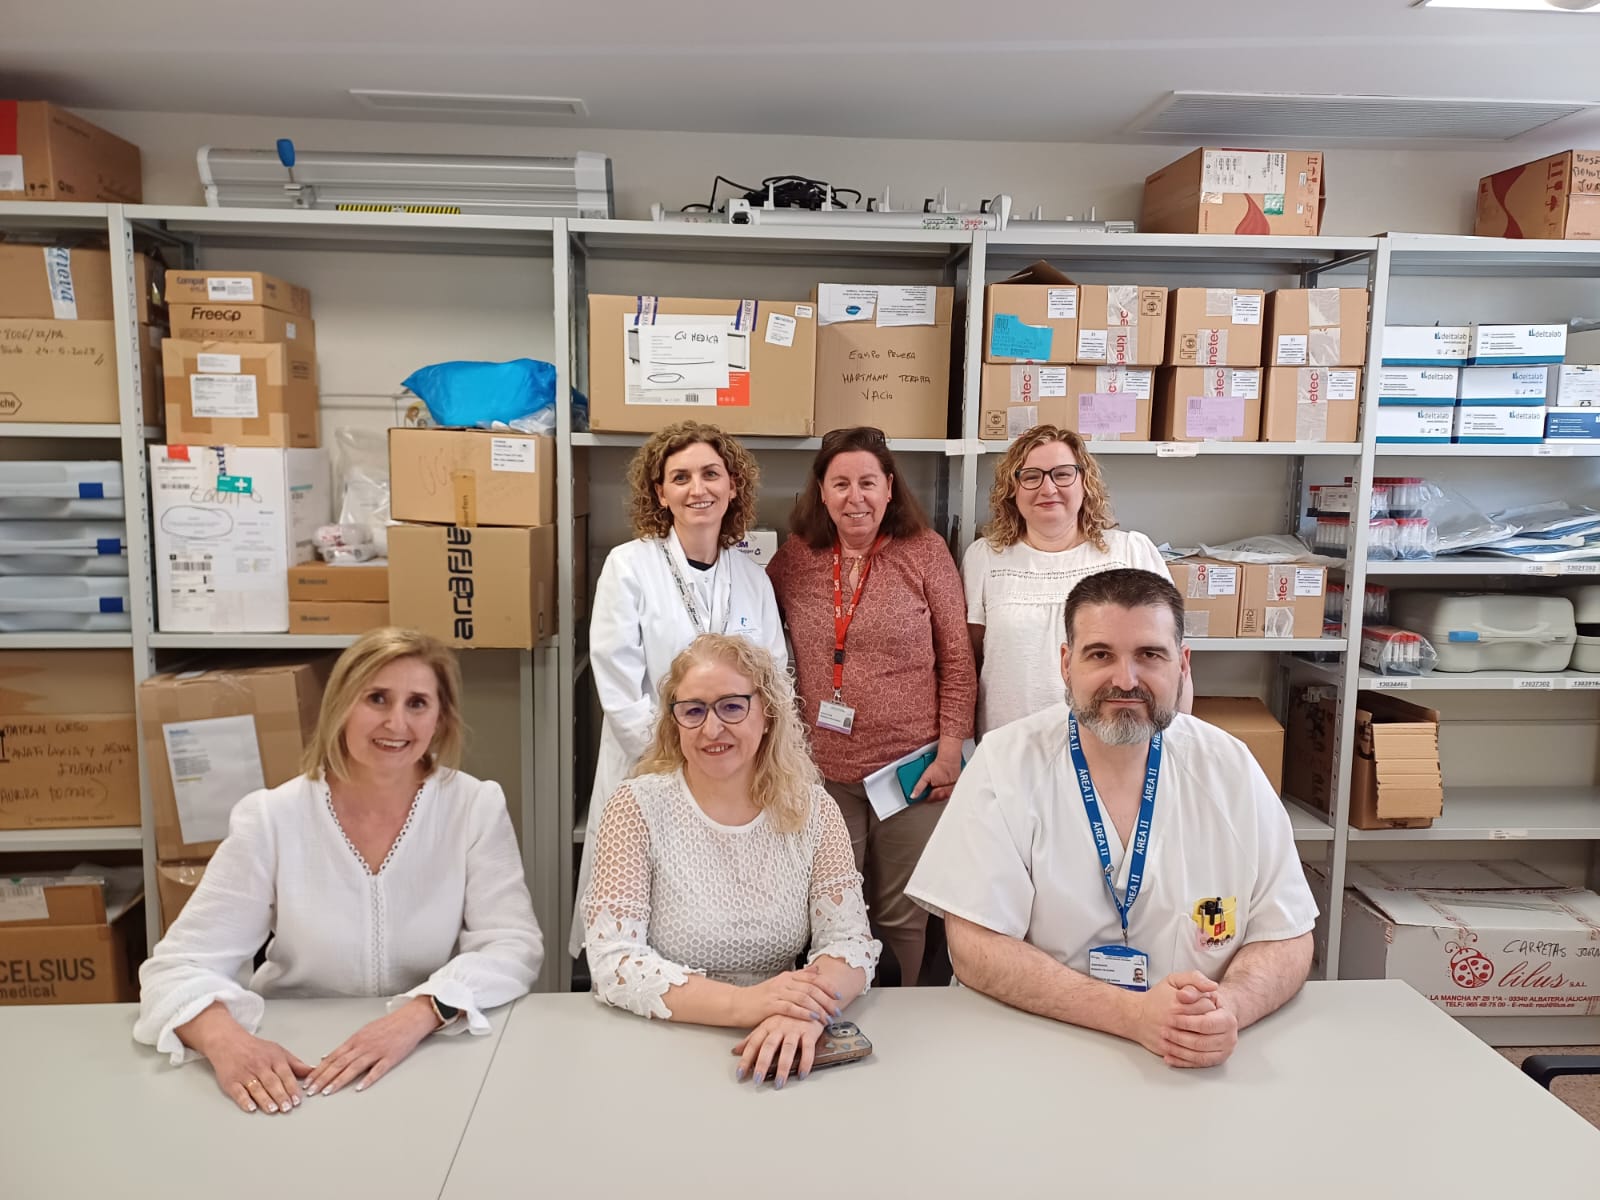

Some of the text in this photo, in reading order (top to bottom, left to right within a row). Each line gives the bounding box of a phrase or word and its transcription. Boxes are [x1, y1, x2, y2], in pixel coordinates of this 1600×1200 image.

[1078, 768, 1091, 793] ÁREA
[1143, 777, 1156, 802] ÁREA
[1093, 821, 1106, 846] ÁREA
[1136, 829, 1149, 856] ÁREA
[1503, 940, 1567, 957] CARPETAS
